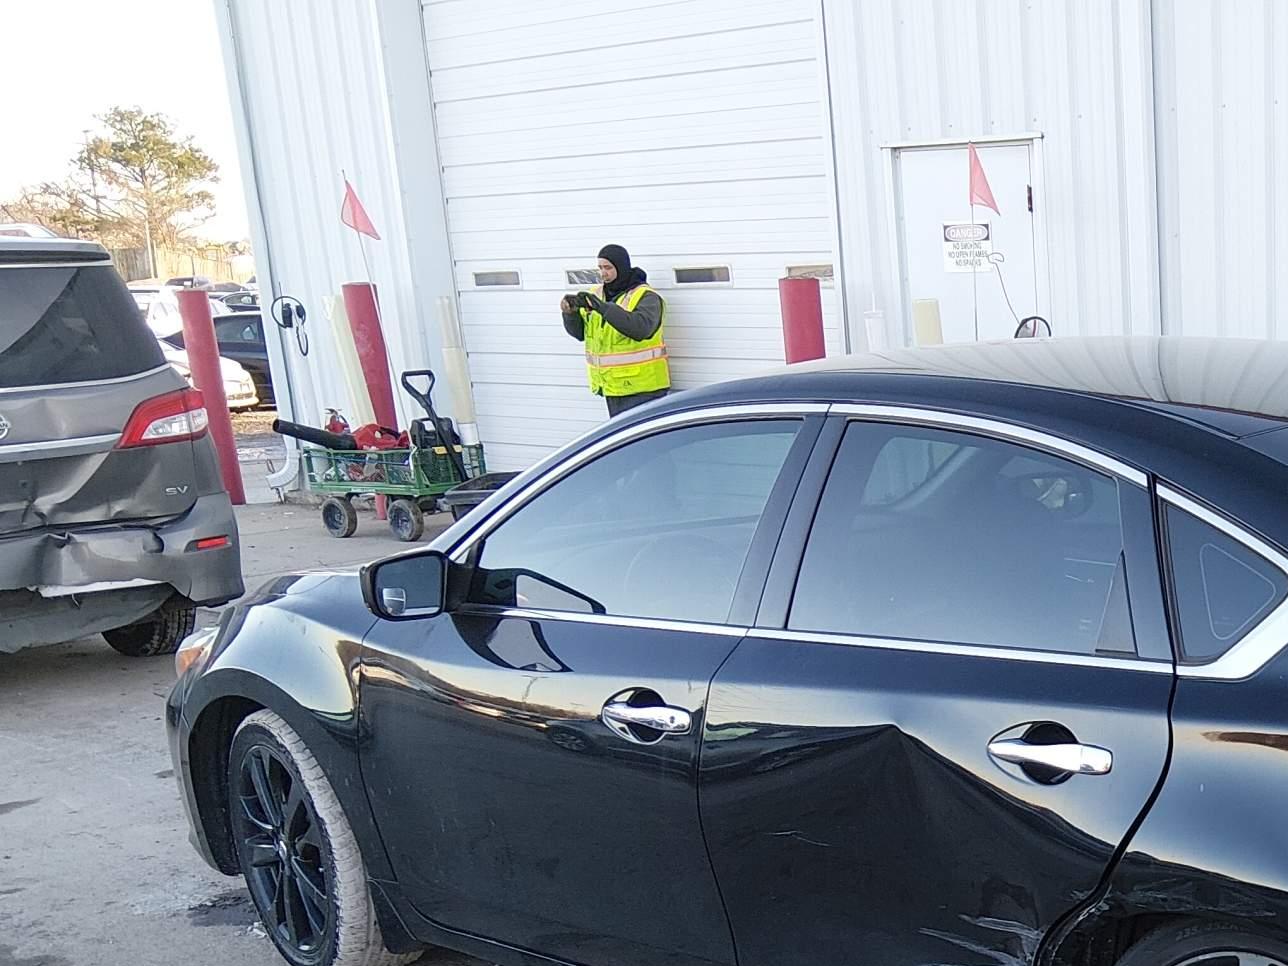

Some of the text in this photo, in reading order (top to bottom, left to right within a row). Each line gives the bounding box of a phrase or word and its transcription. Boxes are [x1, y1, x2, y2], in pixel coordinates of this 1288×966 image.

[950, 227, 982, 239] DANGER
[952, 242, 960, 250] NO
[948, 251, 955, 259] NO
[165, 485, 189, 496] SV
